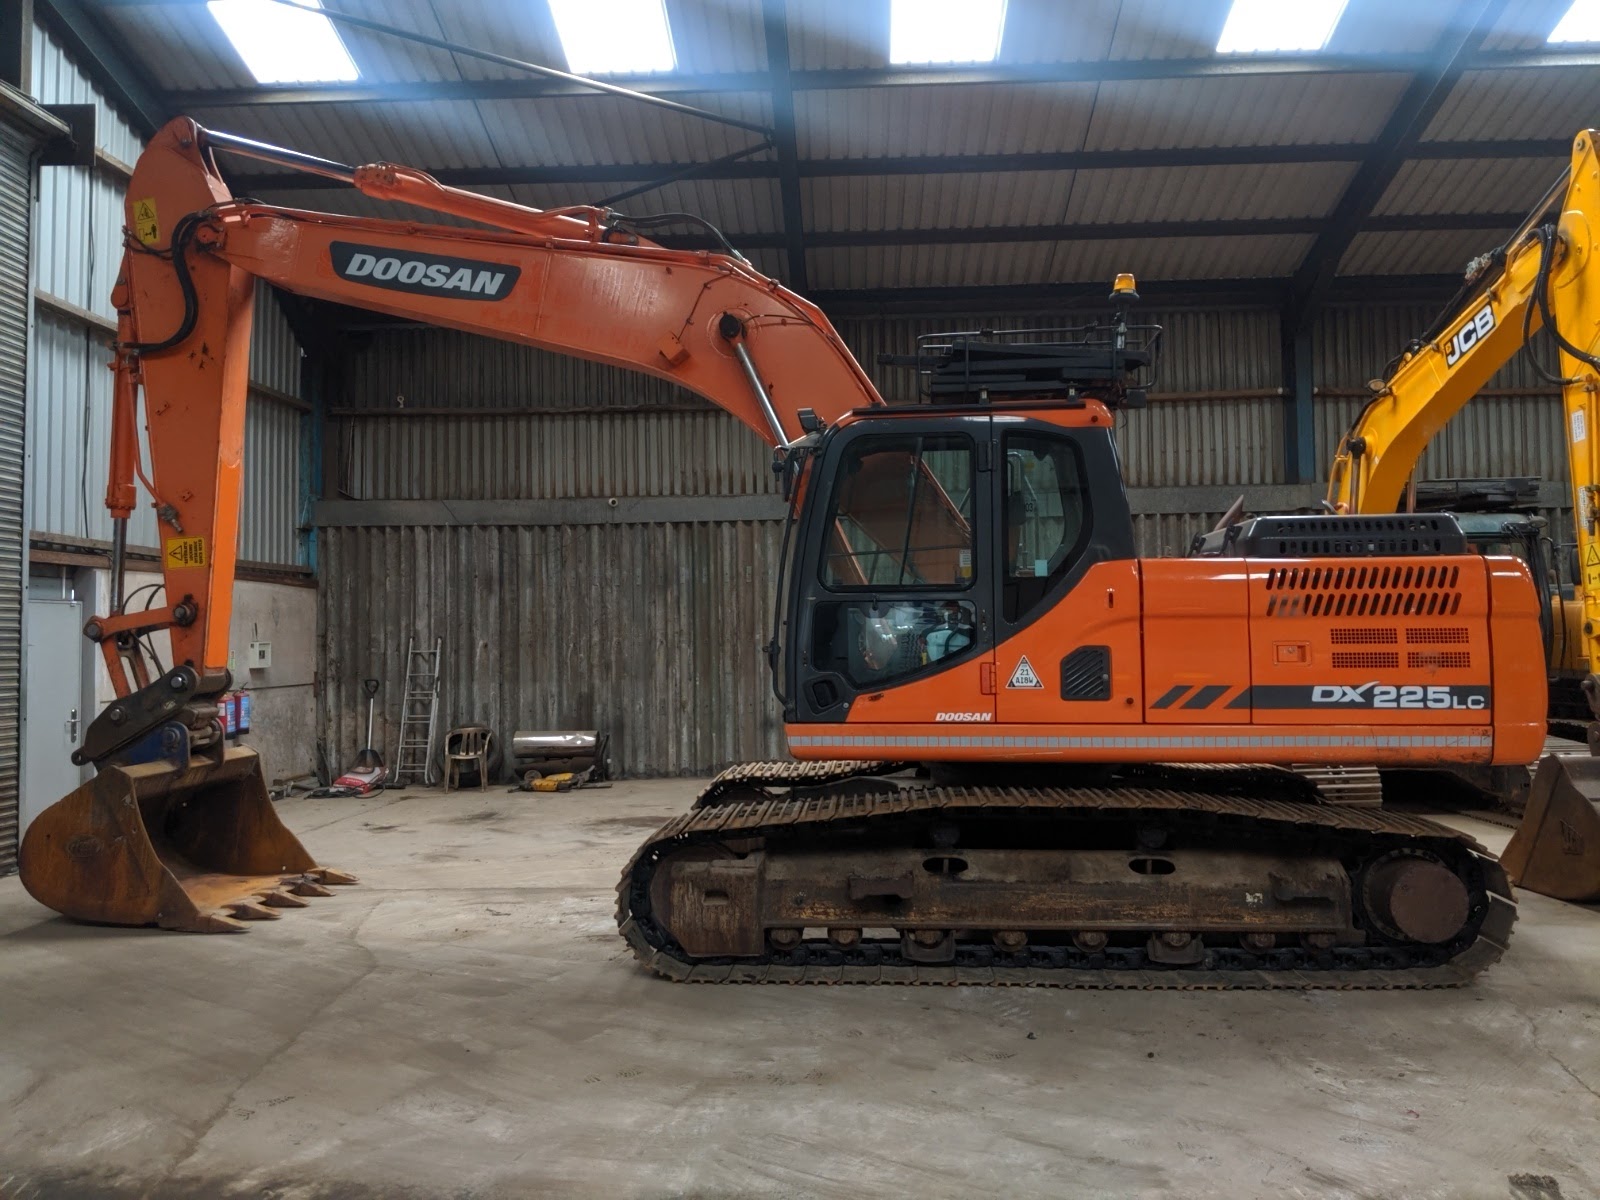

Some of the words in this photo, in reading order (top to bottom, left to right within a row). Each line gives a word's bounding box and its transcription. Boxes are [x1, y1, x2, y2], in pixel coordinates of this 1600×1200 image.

[345, 253, 506, 296] DOOSAN
[1447, 304, 1494, 366] JCB
[1020, 668, 1029, 676] 21
[935, 712, 992, 721] DOOSAN
